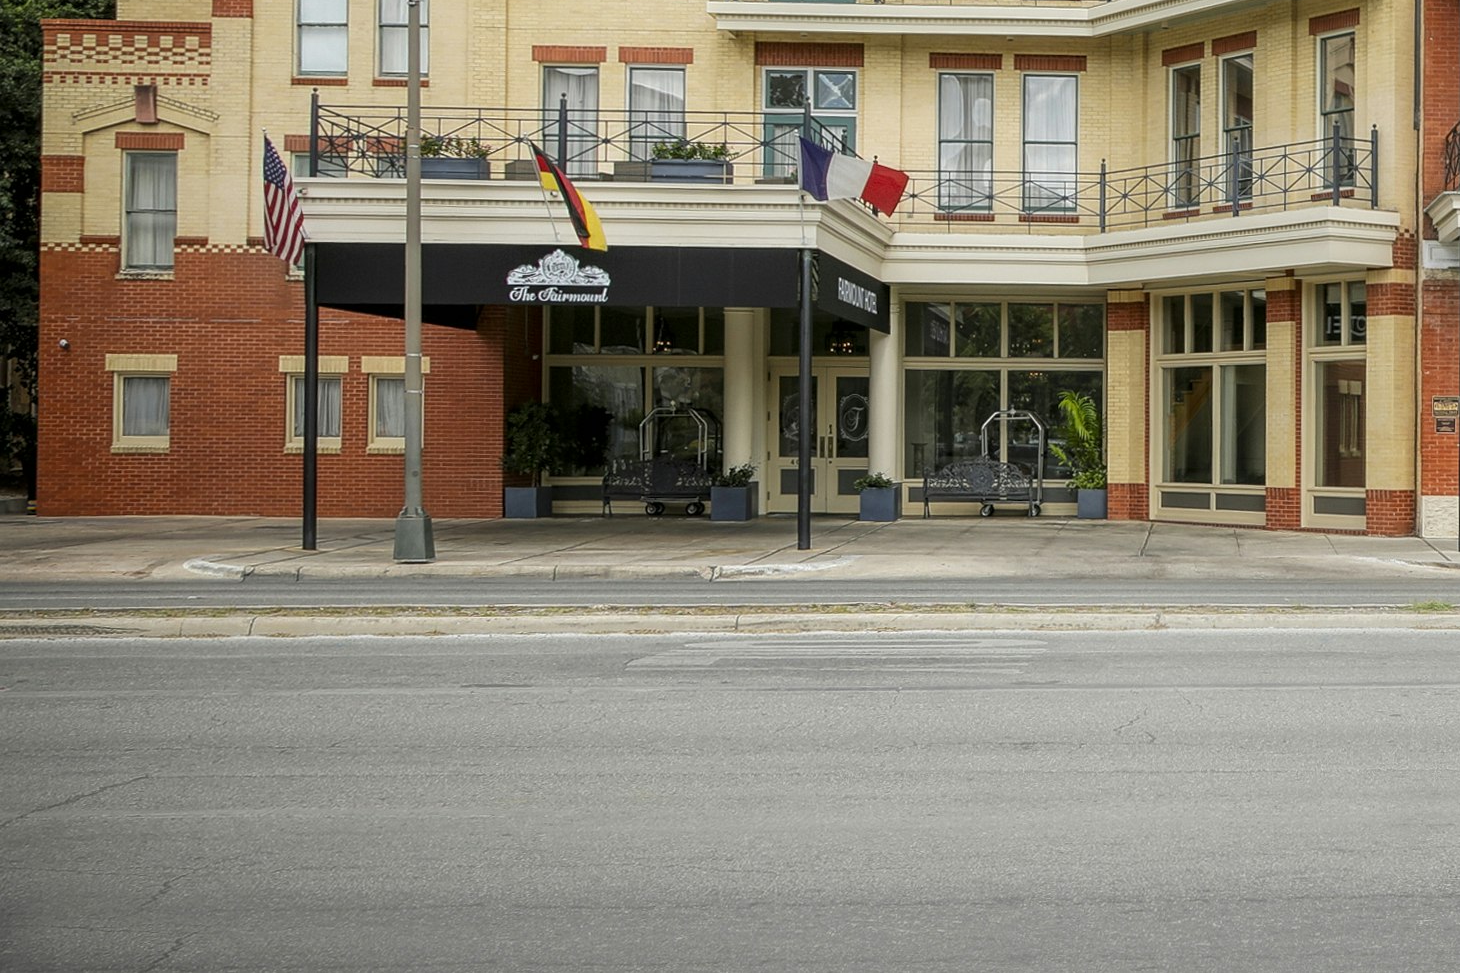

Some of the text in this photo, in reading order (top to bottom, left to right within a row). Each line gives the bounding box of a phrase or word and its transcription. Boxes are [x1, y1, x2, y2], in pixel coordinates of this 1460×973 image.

[509, 286, 609, 303] The Fairmount
[864, 289, 878, 315] HOTEL
